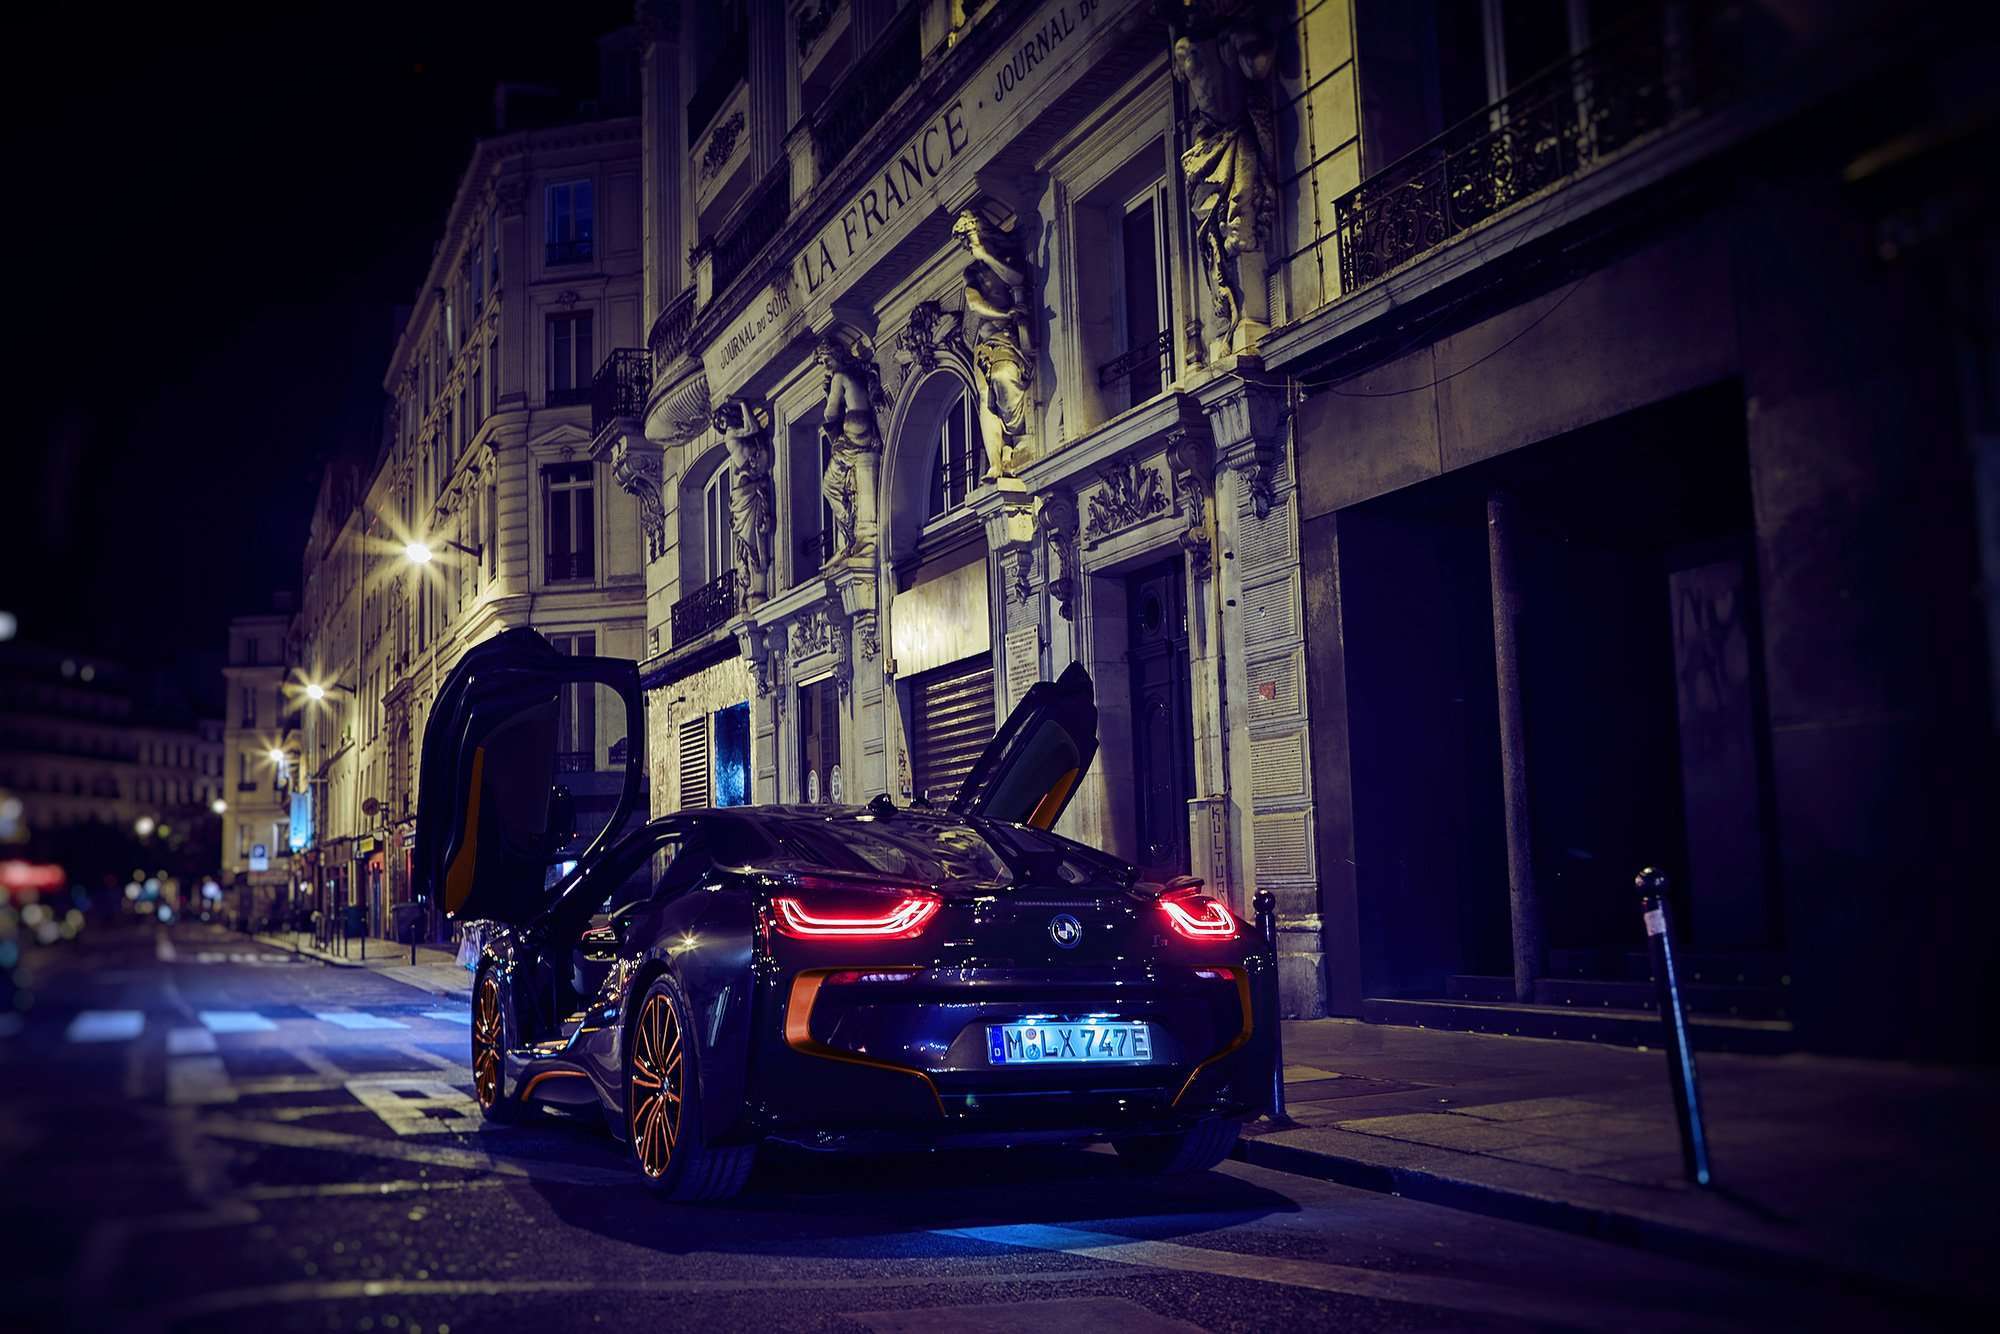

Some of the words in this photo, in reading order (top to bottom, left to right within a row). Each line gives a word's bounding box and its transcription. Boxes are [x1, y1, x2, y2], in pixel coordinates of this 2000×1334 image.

[721, 322, 755, 369] JOURNAL
[766, 288, 791, 323] SOIR
[804, 239, 837, 294] LA
[842, 102, 969, 257] FRANCE
[995, 8, 1075, 101] JOURNAL
[994, 1047, 1001, 1057] D
[1005, 1030, 1024, 1058] M
[1040, 1030, 1075, 1057] LX
[1080, 1028, 1148, 1056] 747E
